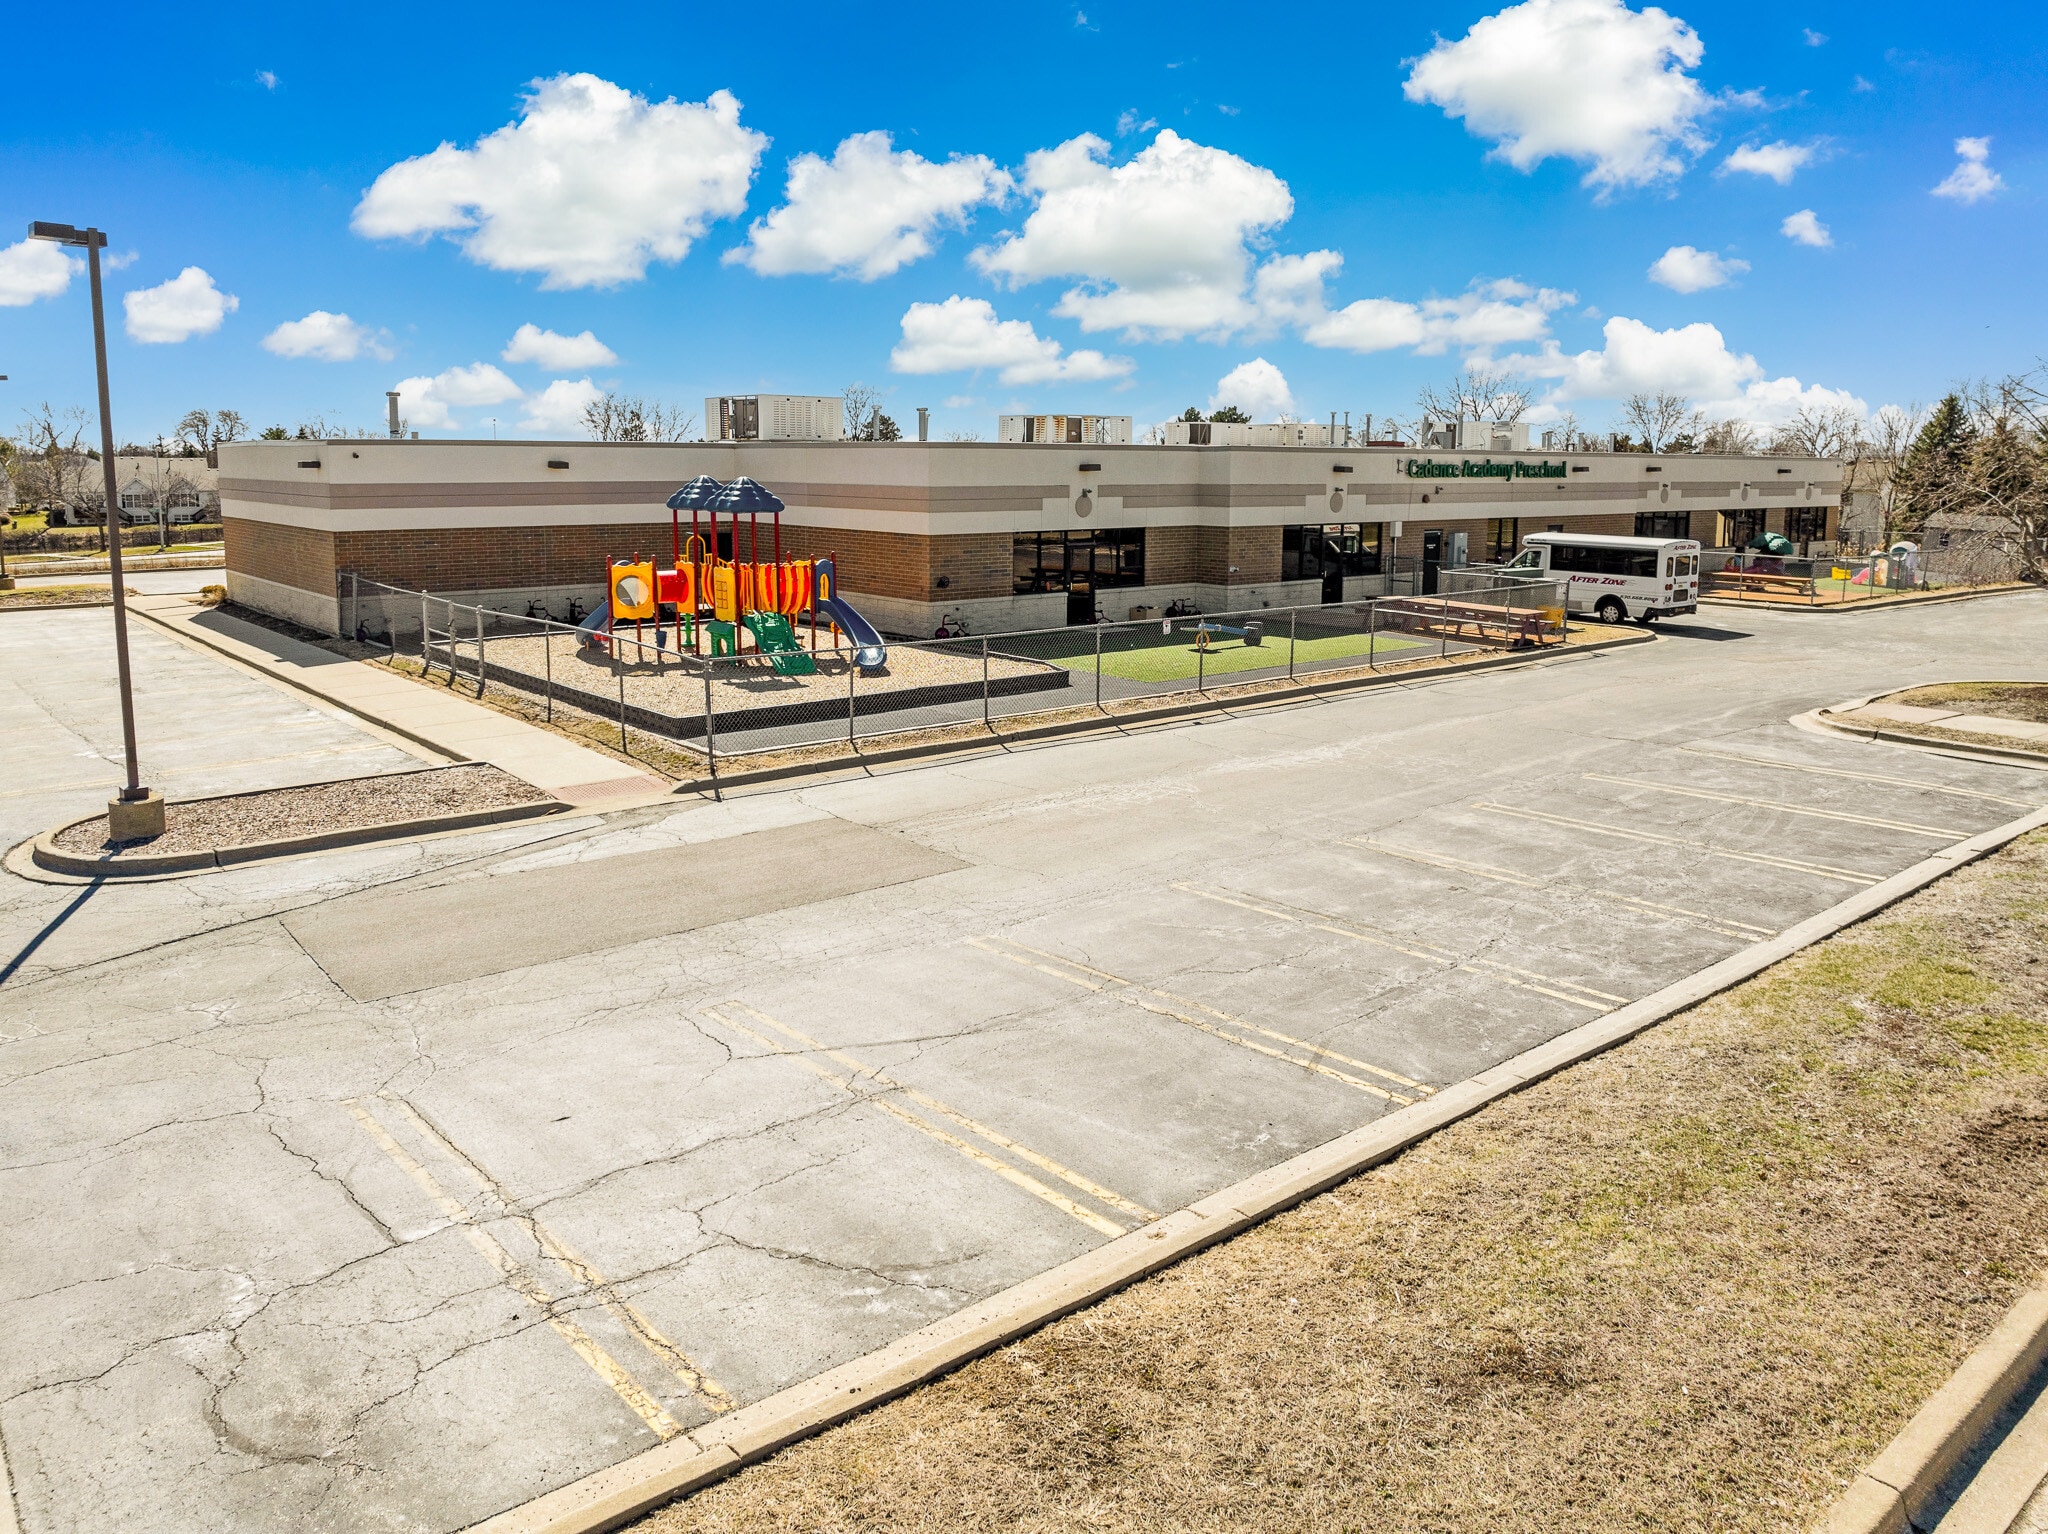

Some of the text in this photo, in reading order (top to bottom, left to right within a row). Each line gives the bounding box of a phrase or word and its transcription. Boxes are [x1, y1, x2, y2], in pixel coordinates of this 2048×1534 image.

[1407, 459, 1567, 482] Cadence Academy Preschool
[1569, 575, 1627, 586] AFTER ZONE
